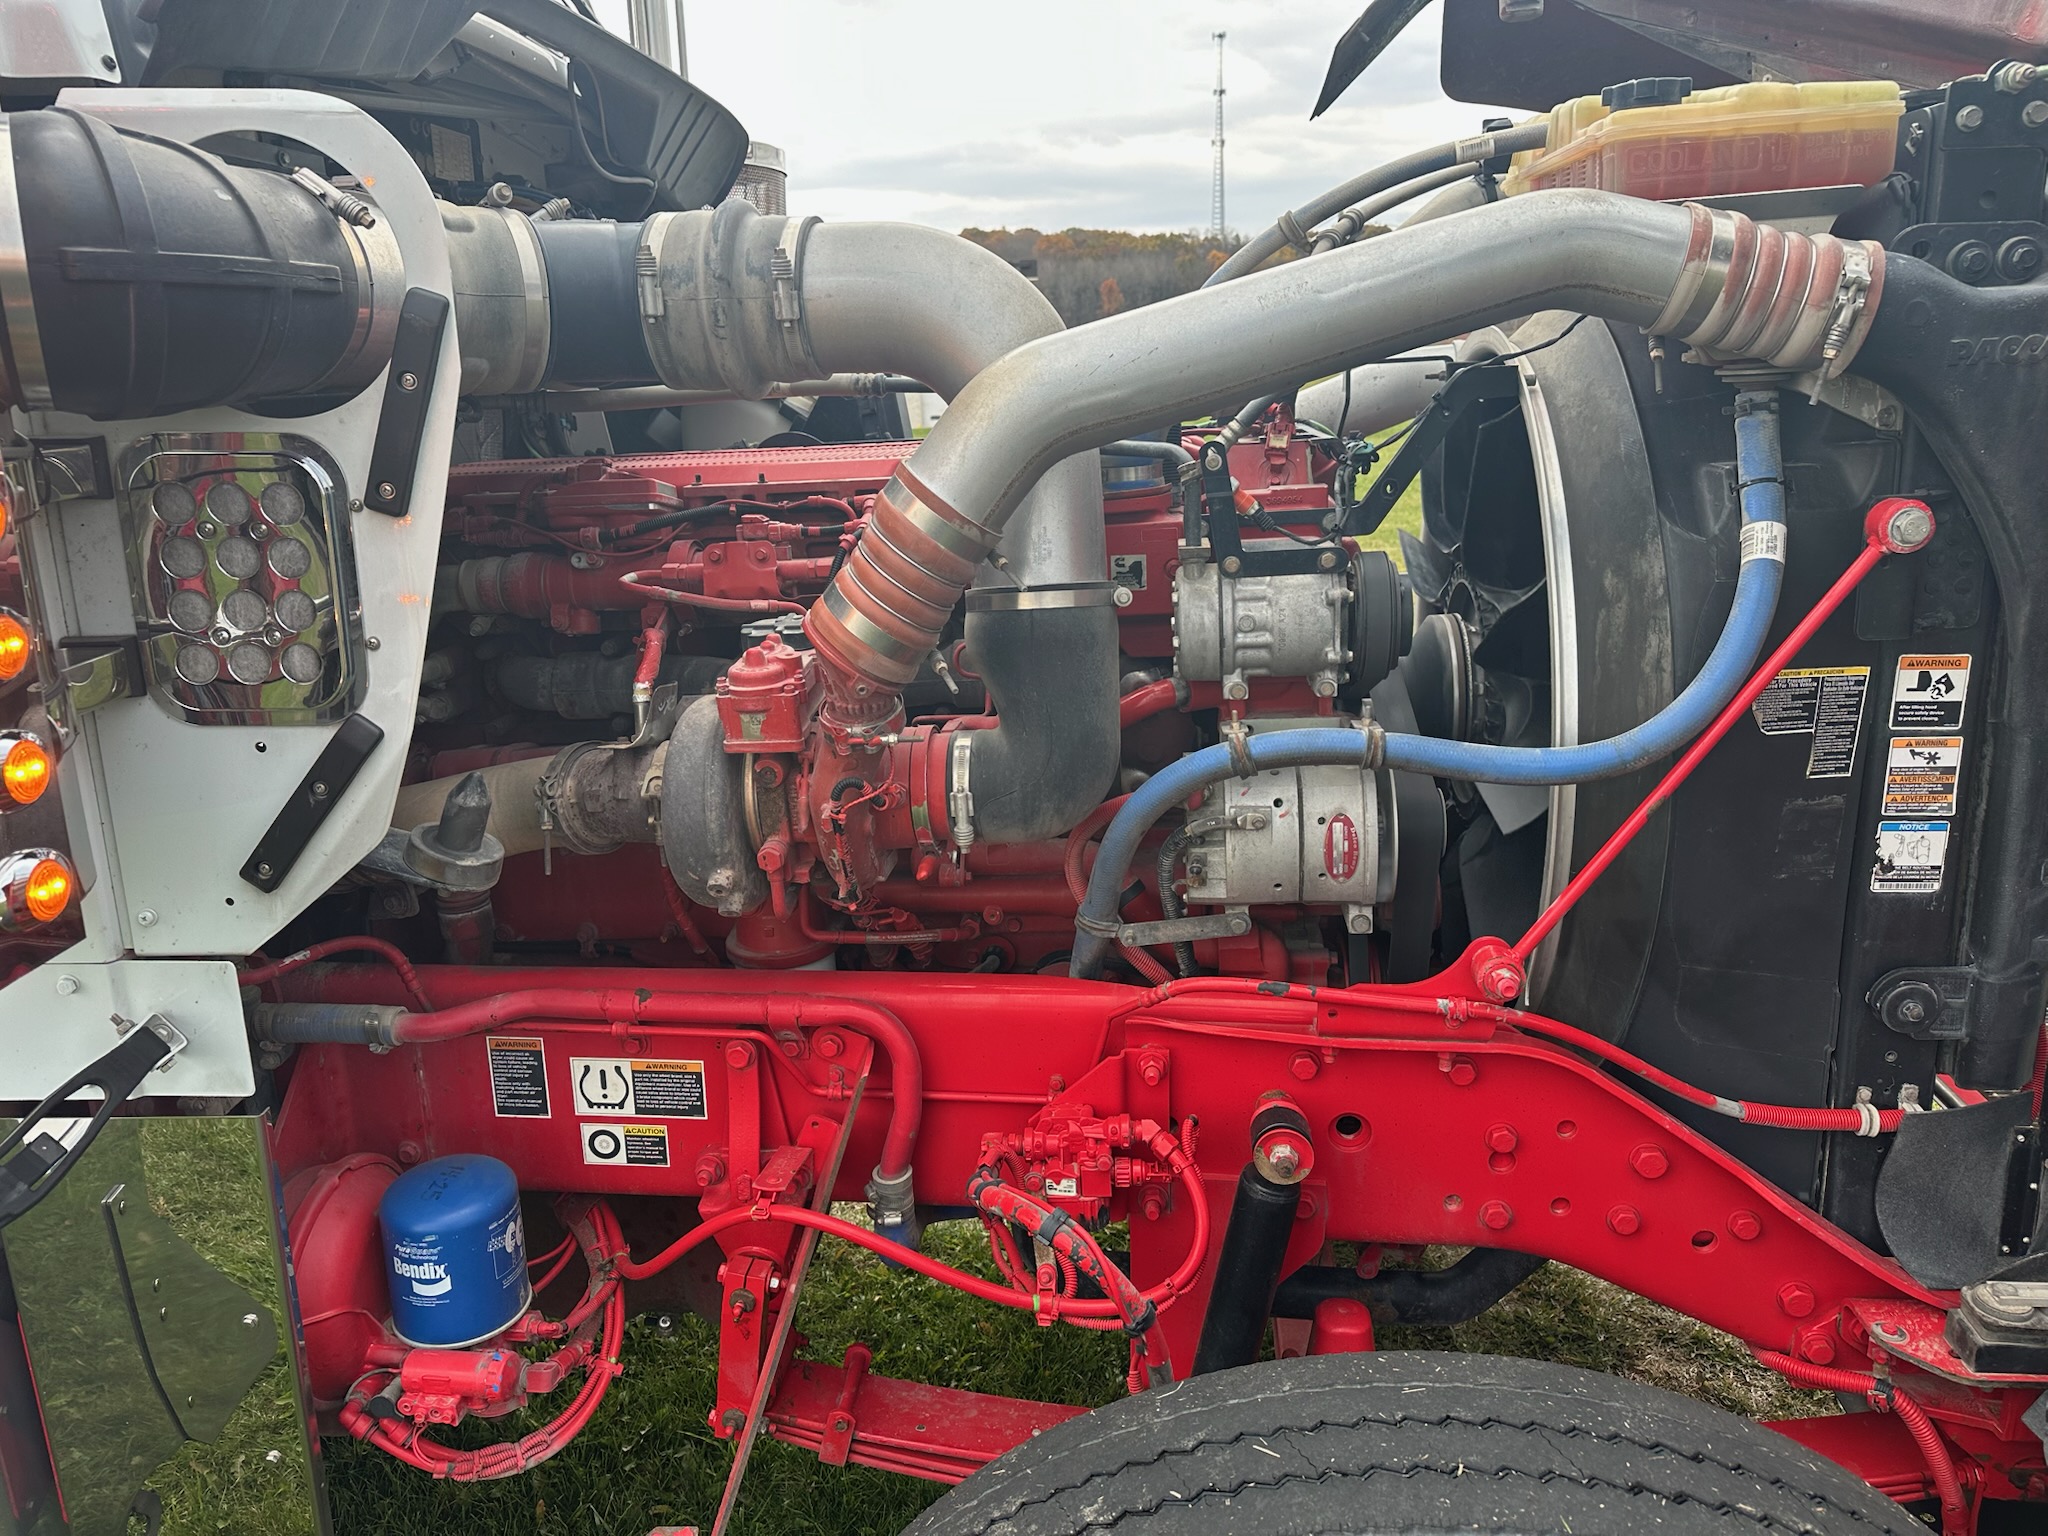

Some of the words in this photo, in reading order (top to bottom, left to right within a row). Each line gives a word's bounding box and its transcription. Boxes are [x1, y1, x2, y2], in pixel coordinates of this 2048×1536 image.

[1628, 142, 1757, 175] COOLANT
[1805, 146, 1841, 161] WHEN
[1849, 145, 1871, 157] HOT
[1947, 333, 2048, 367] PACC
[1350, 827, 1358, 848] Delco
[1350, 850, 1358, 870] Remy
[393, 1256, 446, 1279] Bendix
